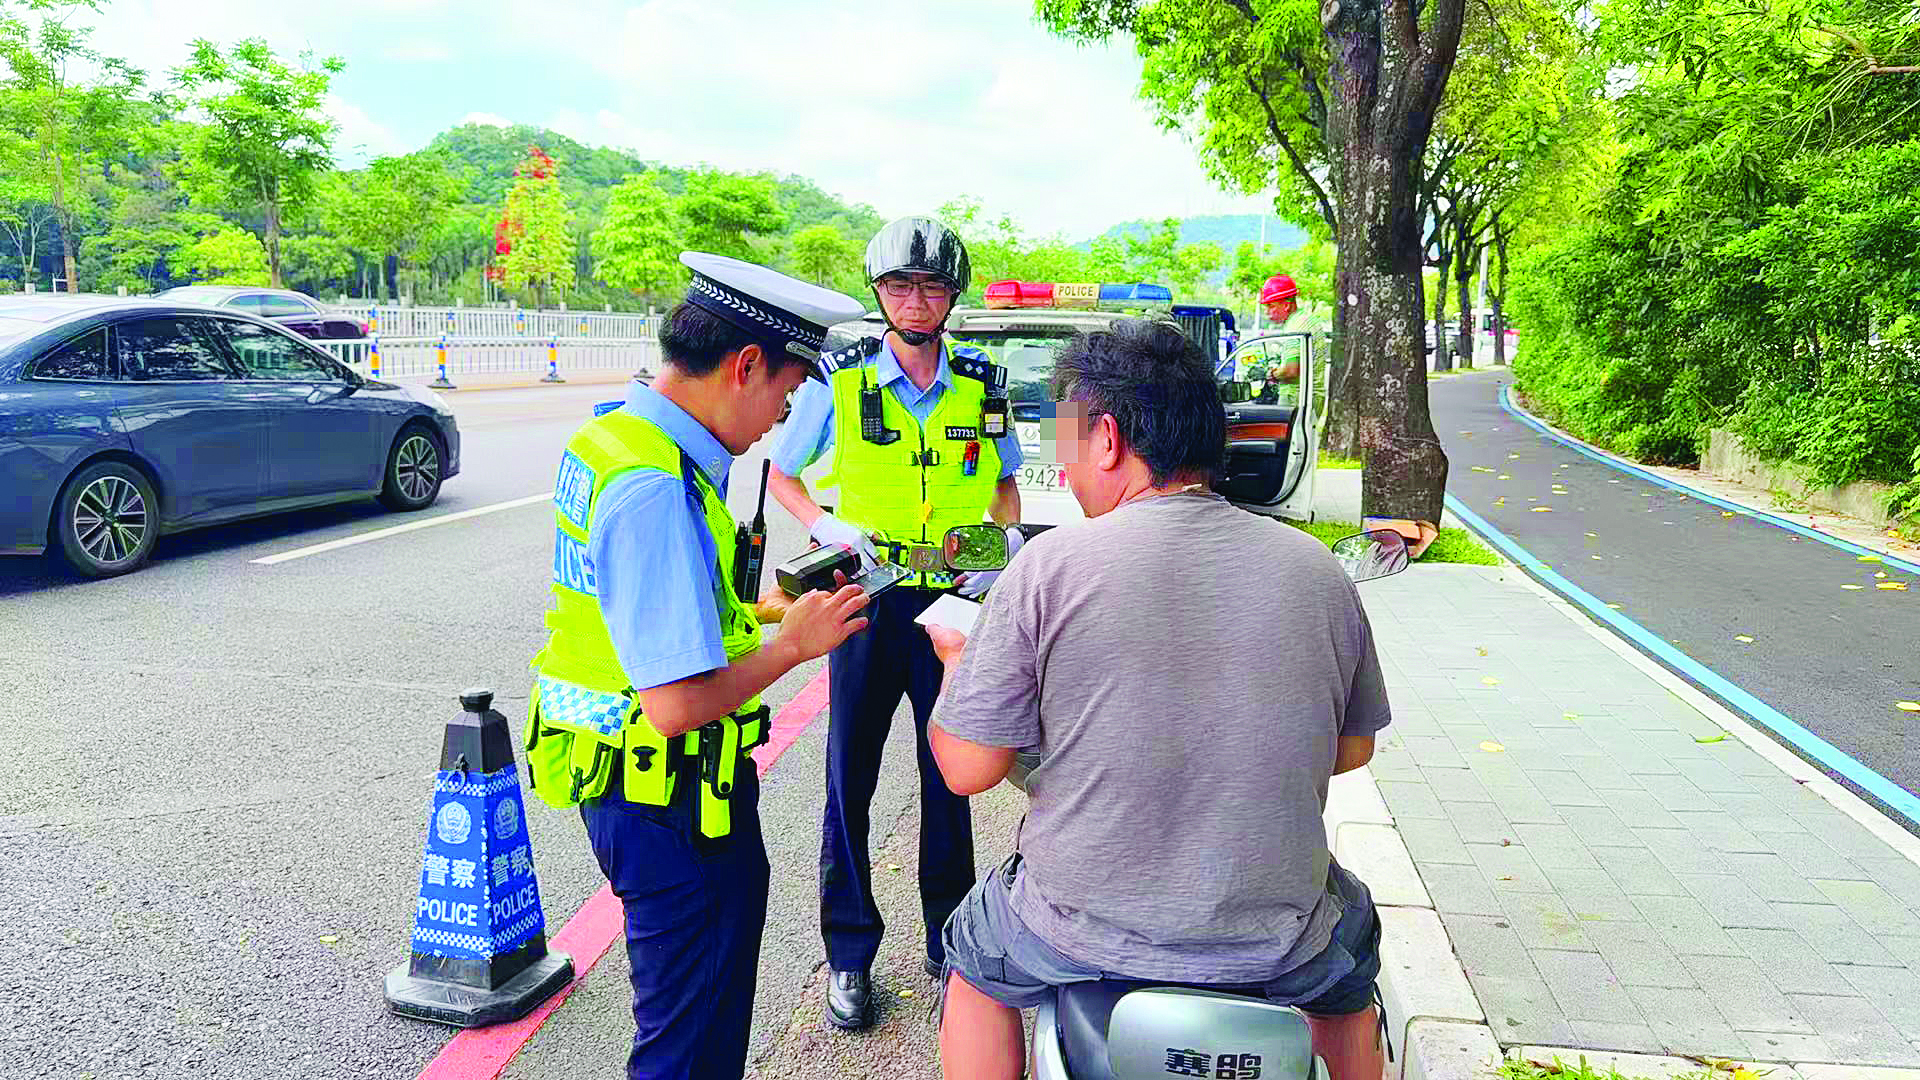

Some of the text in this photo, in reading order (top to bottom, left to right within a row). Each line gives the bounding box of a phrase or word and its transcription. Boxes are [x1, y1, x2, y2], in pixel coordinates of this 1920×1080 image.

[1058, 285, 1094, 297] POLICE
[425, 852, 477, 889] 警察
[492, 844, 535, 888] 警察
[417, 896, 479, 927] POLICE
[492, 883, 536, 926] POLICE
